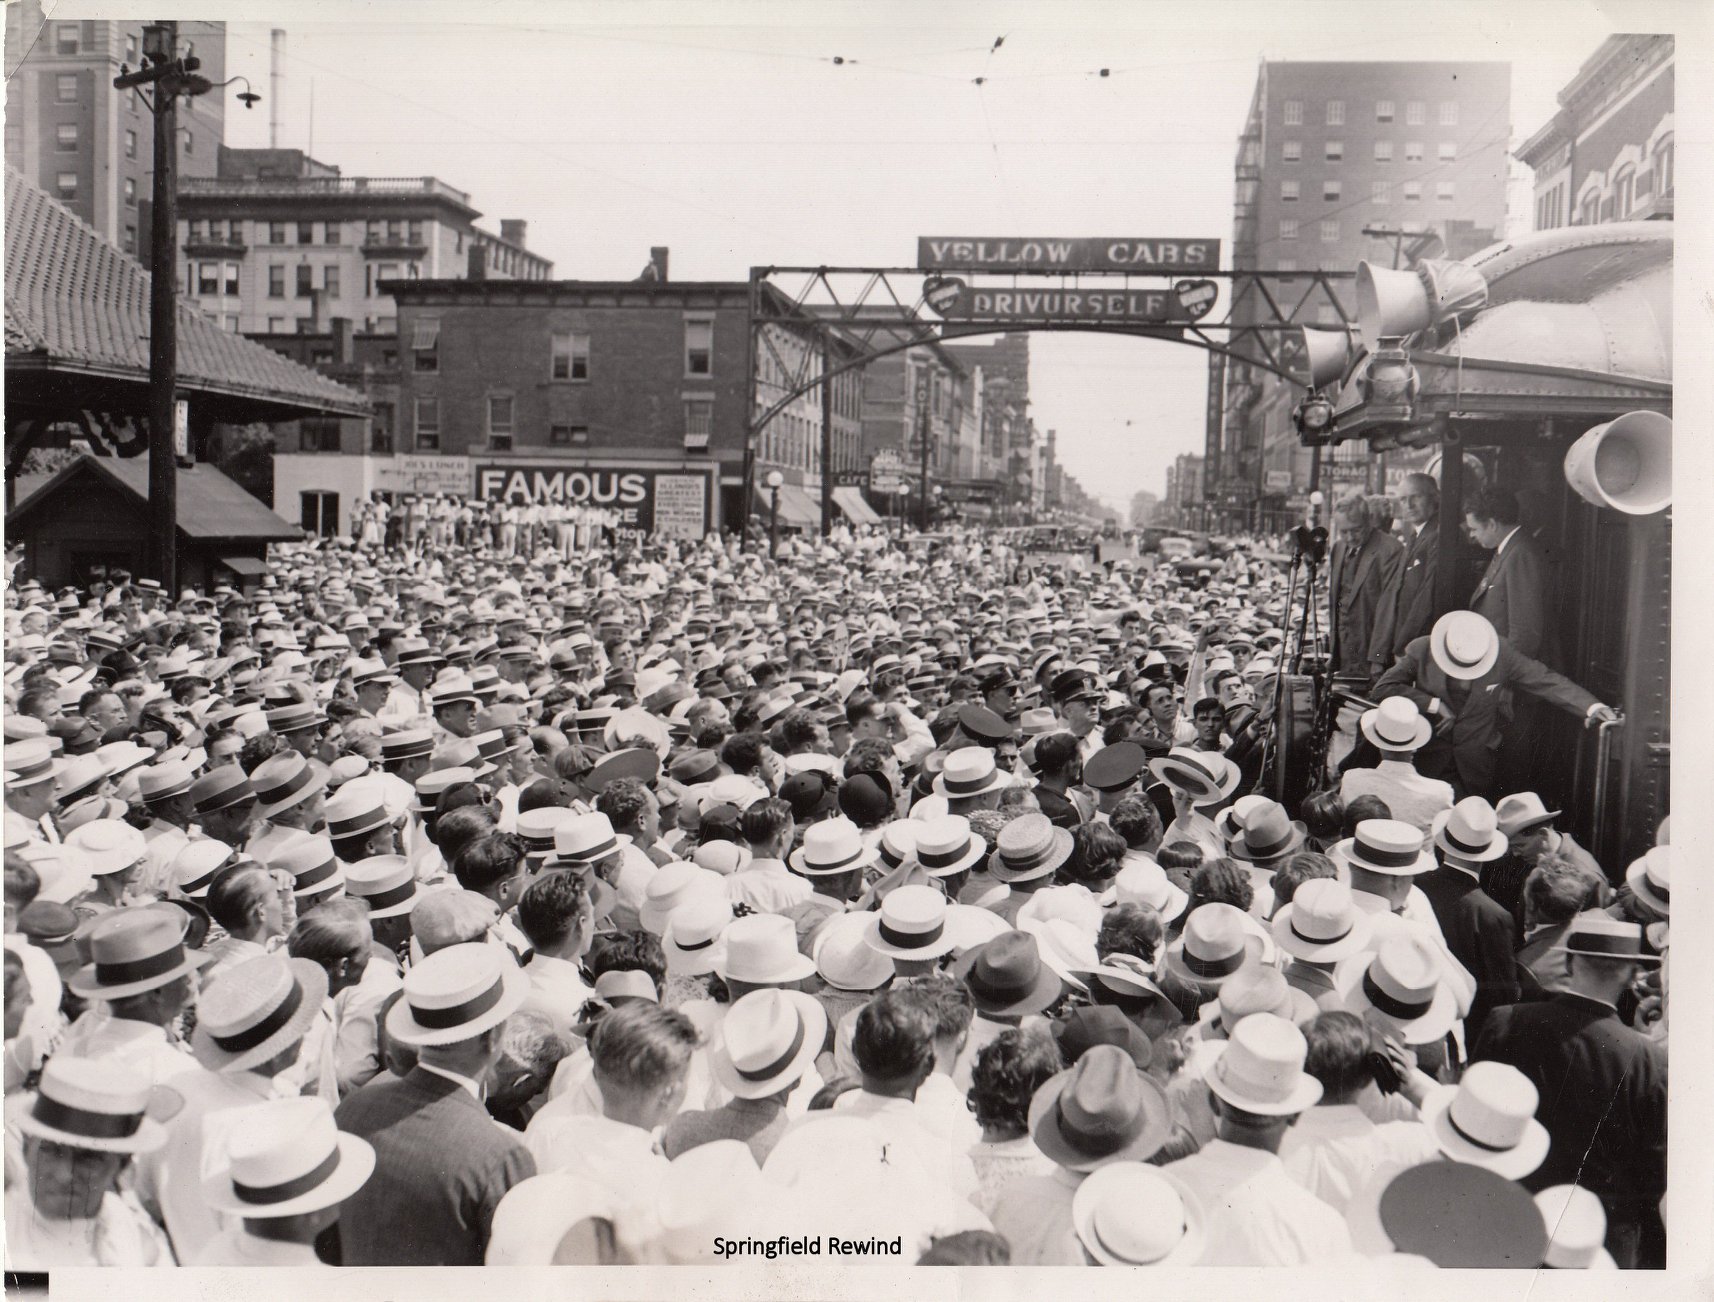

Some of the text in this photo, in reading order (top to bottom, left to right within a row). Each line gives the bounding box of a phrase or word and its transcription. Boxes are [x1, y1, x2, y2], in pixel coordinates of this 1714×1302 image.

[930, 242, 1207, 264] YELLOW CABS
[482, 470, 647, 502] FAMOUS
[839, 475, 868, 486] CAFE
